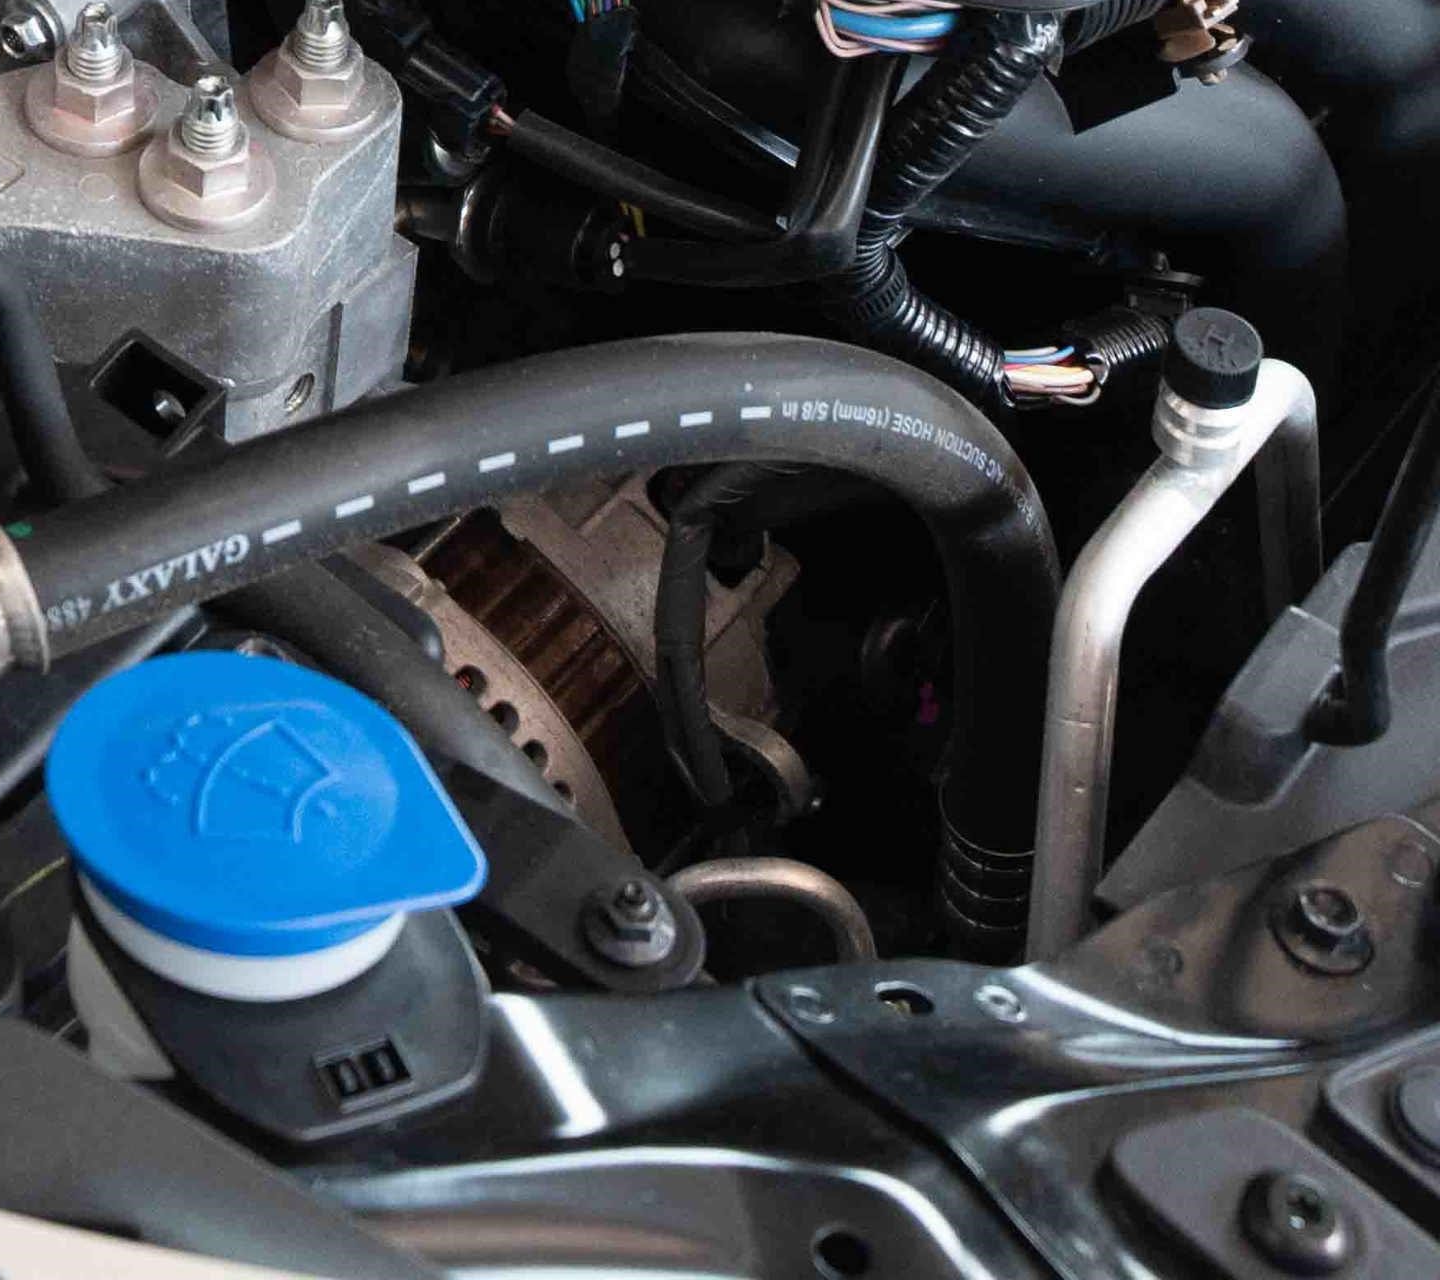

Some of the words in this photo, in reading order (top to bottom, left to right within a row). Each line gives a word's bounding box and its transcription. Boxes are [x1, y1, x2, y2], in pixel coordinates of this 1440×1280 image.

[781, 400, 798, 421] in
[801, 399, 829, 422] 5/8
[833, 399, 891, 430] (16mm)
[891, 412, 934, 442] HOSE
[935, 429, 987, 471] SUCTION
[101, 533, 250, 612] GALAXY
